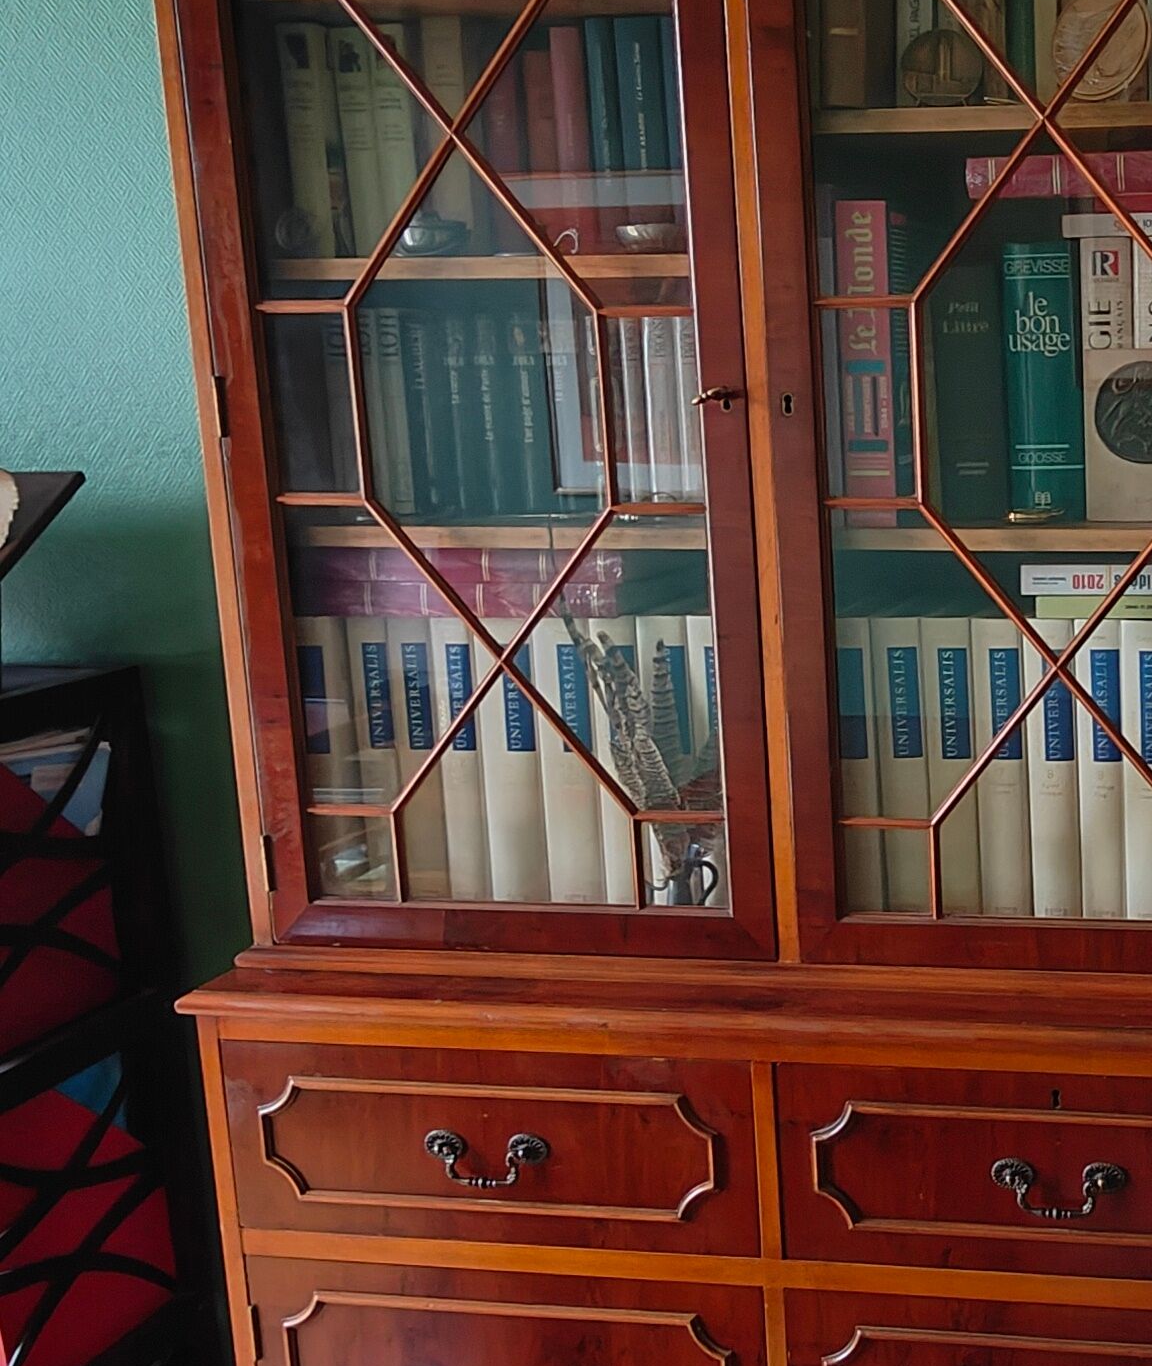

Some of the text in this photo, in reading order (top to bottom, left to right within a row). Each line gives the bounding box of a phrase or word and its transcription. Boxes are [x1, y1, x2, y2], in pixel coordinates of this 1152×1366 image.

[1004, 258, 1070, 274] GREVISSE
[1028, 291, 1048, 315] le
[1015, 309, 1060, 335] bon
[847, 325, 877, 356] Le
[1008, 332, 1071, 357] usage
[1072, 573, 1105, 590] 2010
[1113, 573, 1151, 590] Idés
[365, 644, 385, 747] UNIVERSALIS
[404, 644, 424, 747] UNIVERSALIS
[449, 645, 468, 749] UNERSALIS
[892, 649, 910, 756] UNIVERSALIS
[943, 650, 959, 757] UNIVERSALIS
